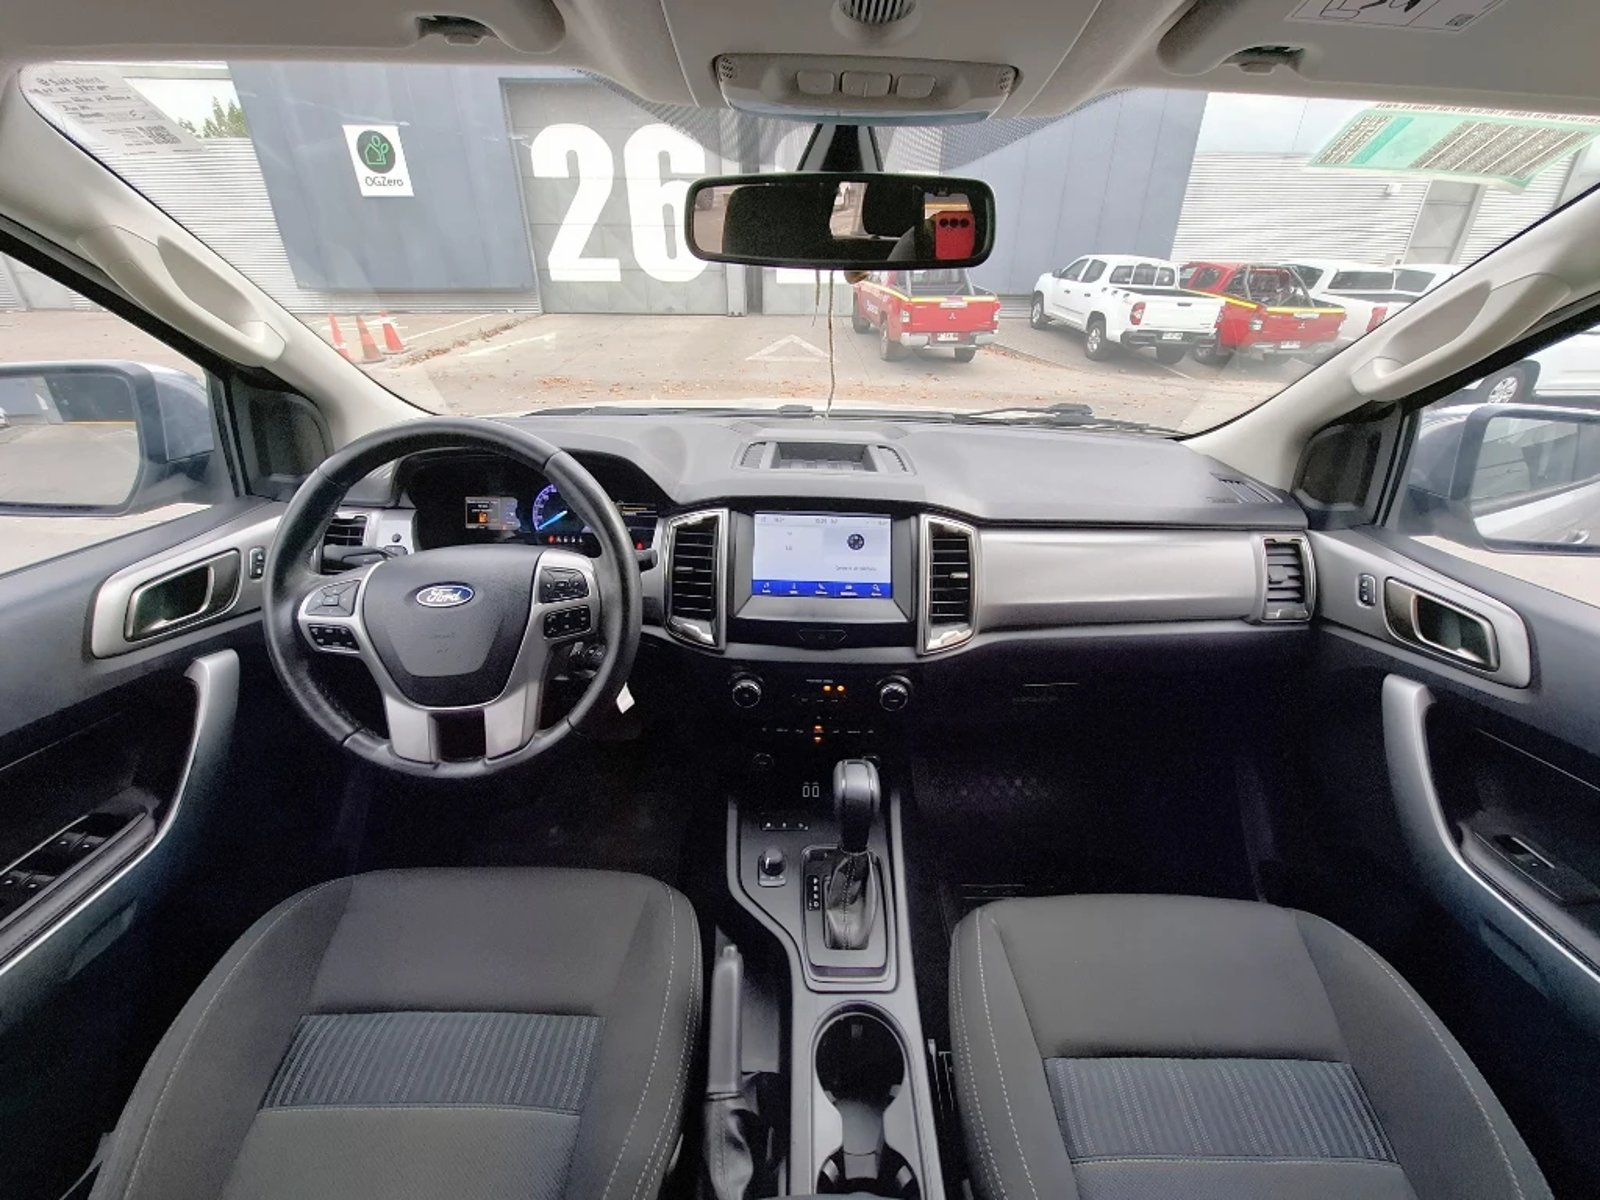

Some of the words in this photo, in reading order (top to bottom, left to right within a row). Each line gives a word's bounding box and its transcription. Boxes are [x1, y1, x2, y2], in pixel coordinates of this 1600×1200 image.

[364, 176, 404, 187] OGZero
[531, 122, 710, 282] 26
[425, 587, 464, 603] Ford
